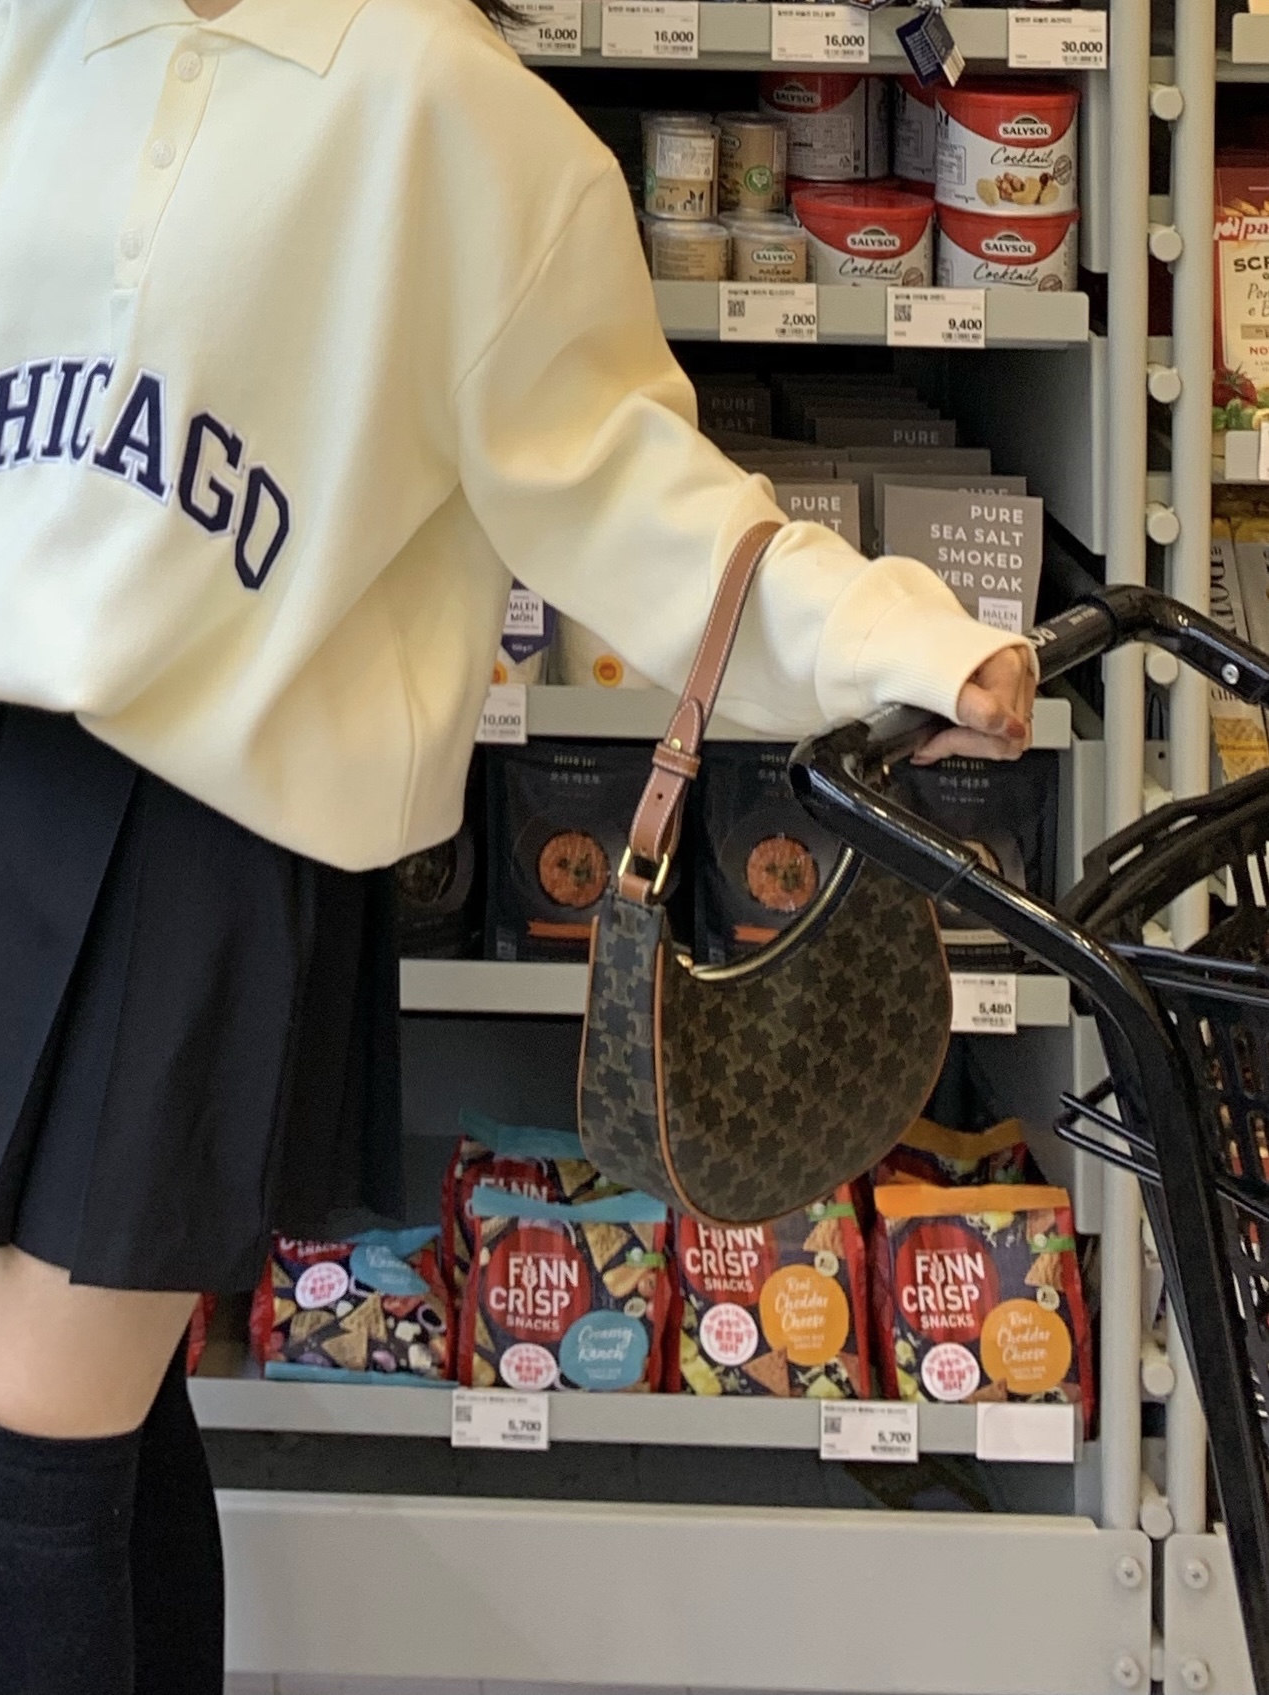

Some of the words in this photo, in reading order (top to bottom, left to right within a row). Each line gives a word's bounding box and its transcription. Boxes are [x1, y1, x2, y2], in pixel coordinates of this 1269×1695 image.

[537, 27, 578, 41] 16,000
[653, 30, 695, 43] 16,000
[824, 34, 866, 48] 16,000
[1061, 40, 1104, 54] 30,000
[1001, 125, 1050, 137] SALYSOL
[989, 146, 1054, 166] Cocktail
[850, 236, 898, 248] SALYSOL
[984, 242, 1033, 254] SALYSOL
[838, 257, 902, 278] Cocktail
[973, 262, 1039, 284] Cocktail
[782, 313, 817, 327] 2,000
[947, 318, 983, 332] 9,400
[893, 429, 940, 445] PURE
[790, 496, 842, 512] PURE
[971, 505, 1024, 525] PURE
[930, 524, 968, 541] SEA
[974, 528, 1024, 547] SALT
[938, 547, 1023, 570] SMOKED
[937, 568, 975, 588] VER
[981, 574, 1023, 593] OAK
[982, 608, 1018, 622] HALEN
[482, 714, 522, 727] 10,000
[508, 1254, 579, 1289] FINN
[684, 1248, 759, 1278] CRISP
[915, 1252, 985, 1284] FINN
[703, 1277, 755, 1293] SNACKS
[489, 1286, 571, 1318] CRISP
[775, 1291, 829, 1314] Cheddar
[901, 1284, 980, 1314] CRISP
[506, 1316, 561, 1332] SNACKS
[781, 1311, 827, 1333] Cheese
[920, 1313, 975, 1330] SNACKS
[578, 1325, 635, 1346] Creamy
[997, 1323, 1051, 1347] Cheddar
[577, 1342, 626, 1363] Ranch
[1002, 1346, 1048, 1364] Cheese
[508, 1419, 542, 1433] 5,700
[877, 1431, 912, 1445] 5,700
